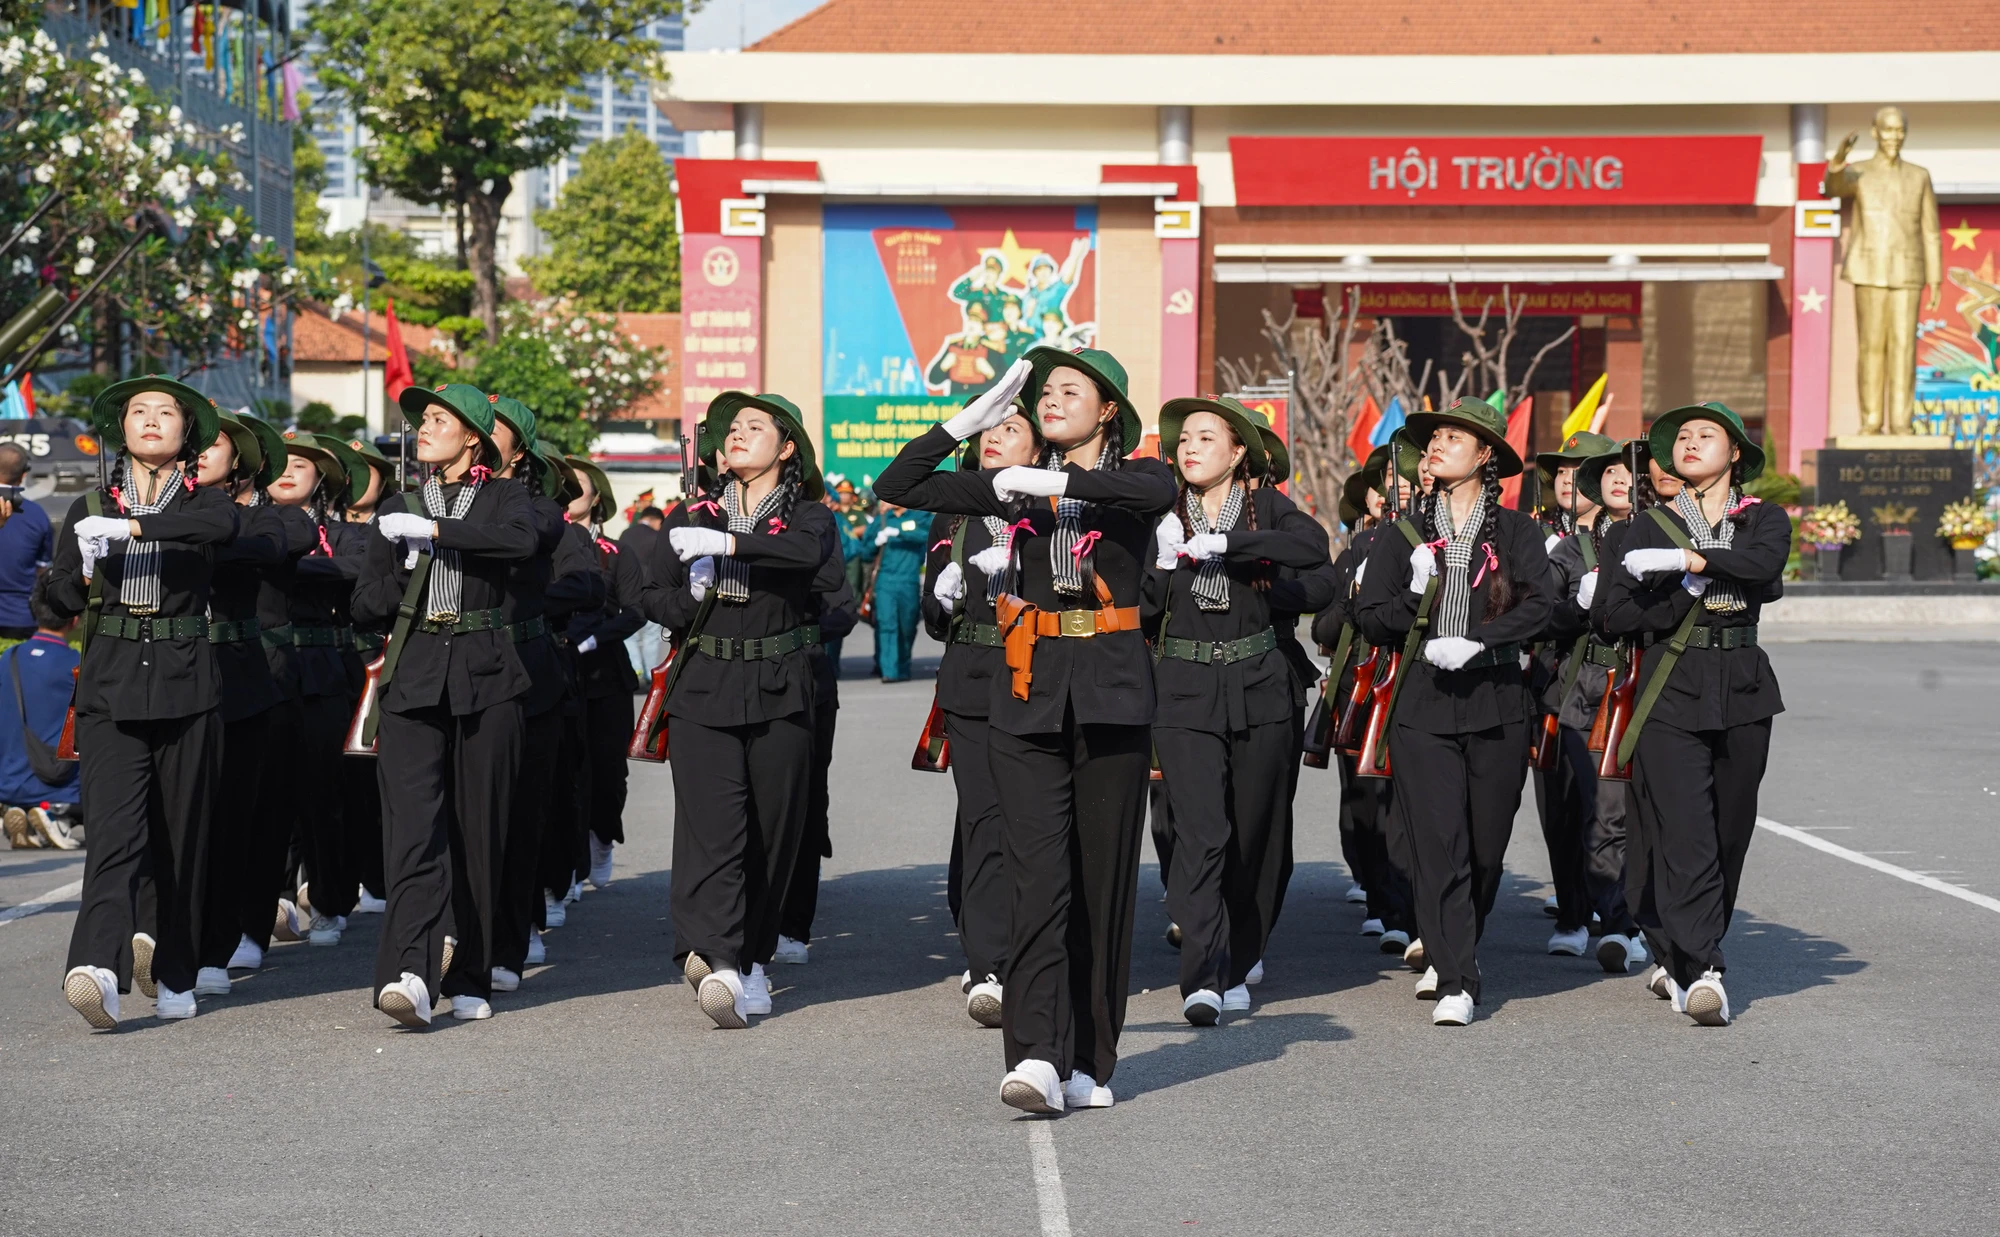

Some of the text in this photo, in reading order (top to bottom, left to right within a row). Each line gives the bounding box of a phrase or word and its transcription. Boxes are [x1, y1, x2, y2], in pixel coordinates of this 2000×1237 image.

[1369, 146, 1623, 198] HỘI TRƯỜNG
[1572, 289, 1596, 311] HỘI
